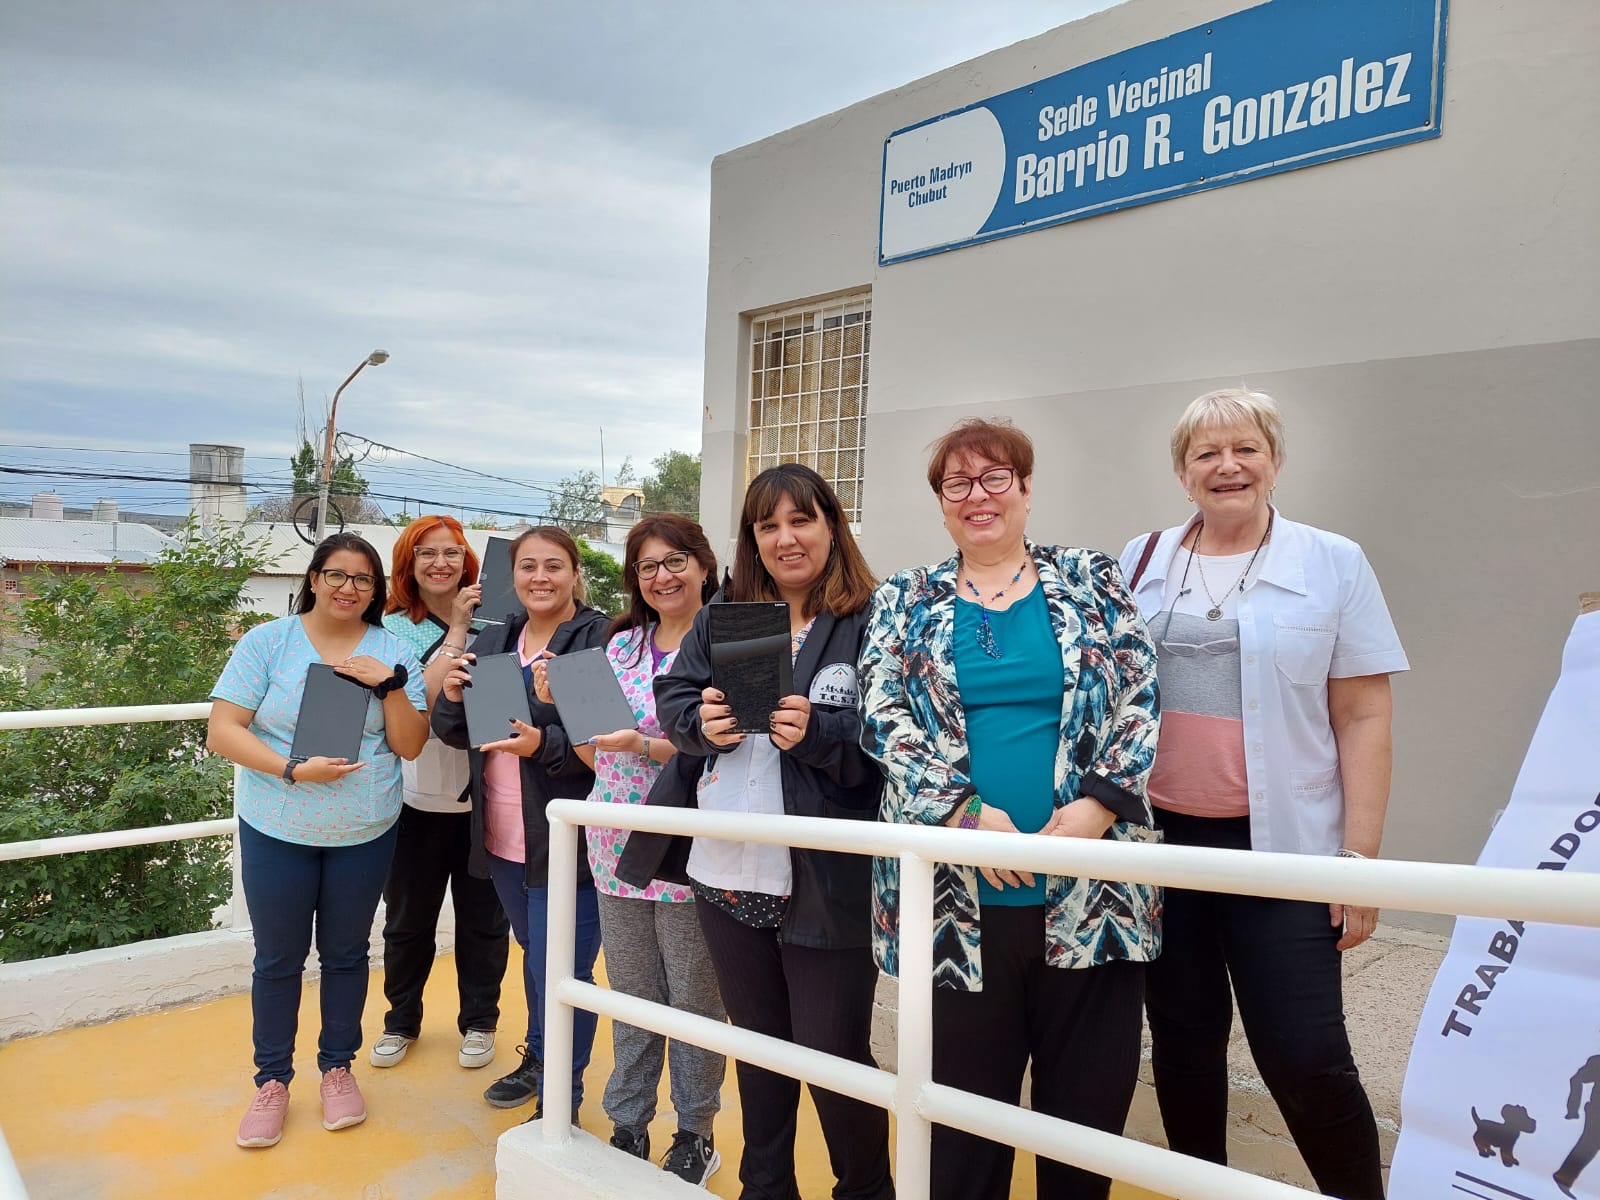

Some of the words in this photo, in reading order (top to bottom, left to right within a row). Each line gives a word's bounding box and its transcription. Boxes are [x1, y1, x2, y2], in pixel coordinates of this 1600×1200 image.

[1014, 130, 1129, 205] Barrio
[1143, 113, 1185, 170] R.
[1202, 52, 1412, 155] Gonzalez
[1038, 95, 1098, 142] Sede
[1107, 52, 1212, 119] Vecinal
[890, 175, 926, 196] Puerto
[929, 160, 972, 185] Madryn
[908, 185, 948, 208] Chubut
[1441, 792, 1600, 1037] TRABADO
